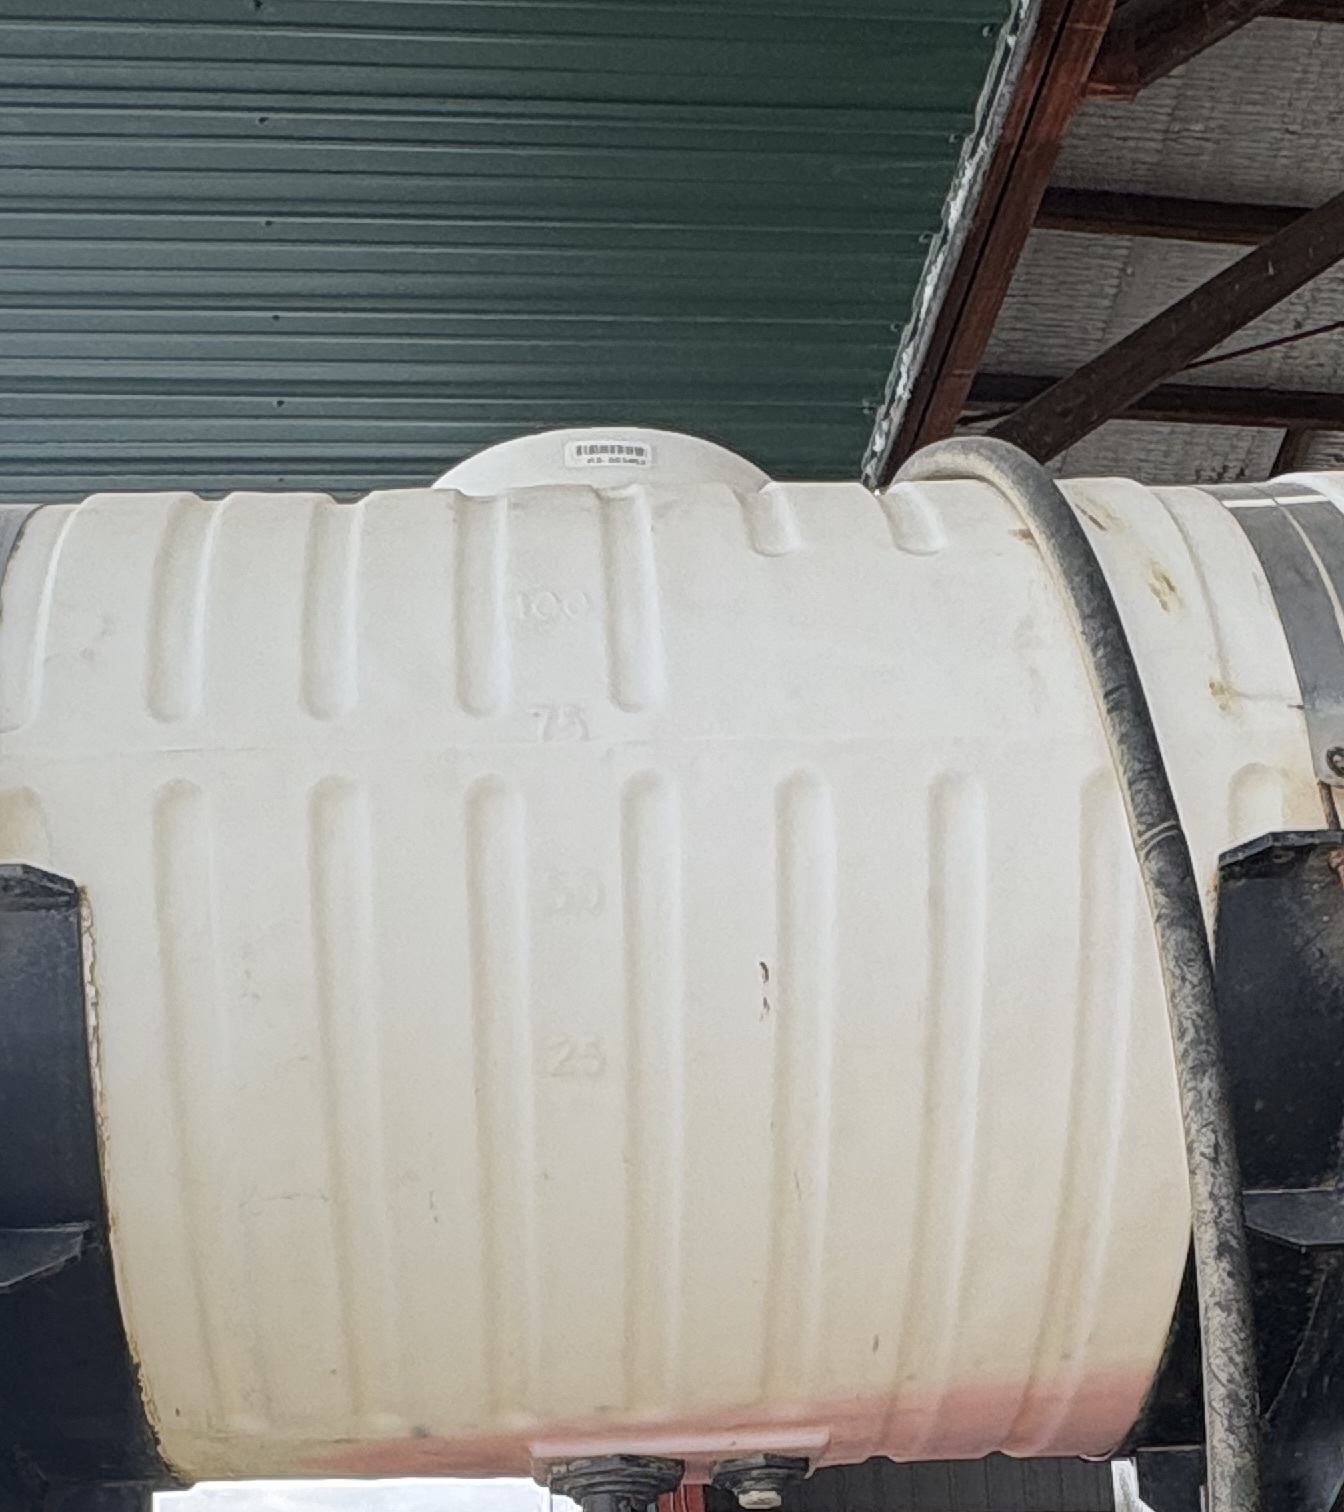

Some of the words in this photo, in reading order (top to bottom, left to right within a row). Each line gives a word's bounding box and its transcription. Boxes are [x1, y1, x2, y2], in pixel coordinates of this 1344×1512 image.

[515, 590, 592, 622] 100
[527, 703, 593, 742] 75
[542, 1033, 609, 1080] 25
